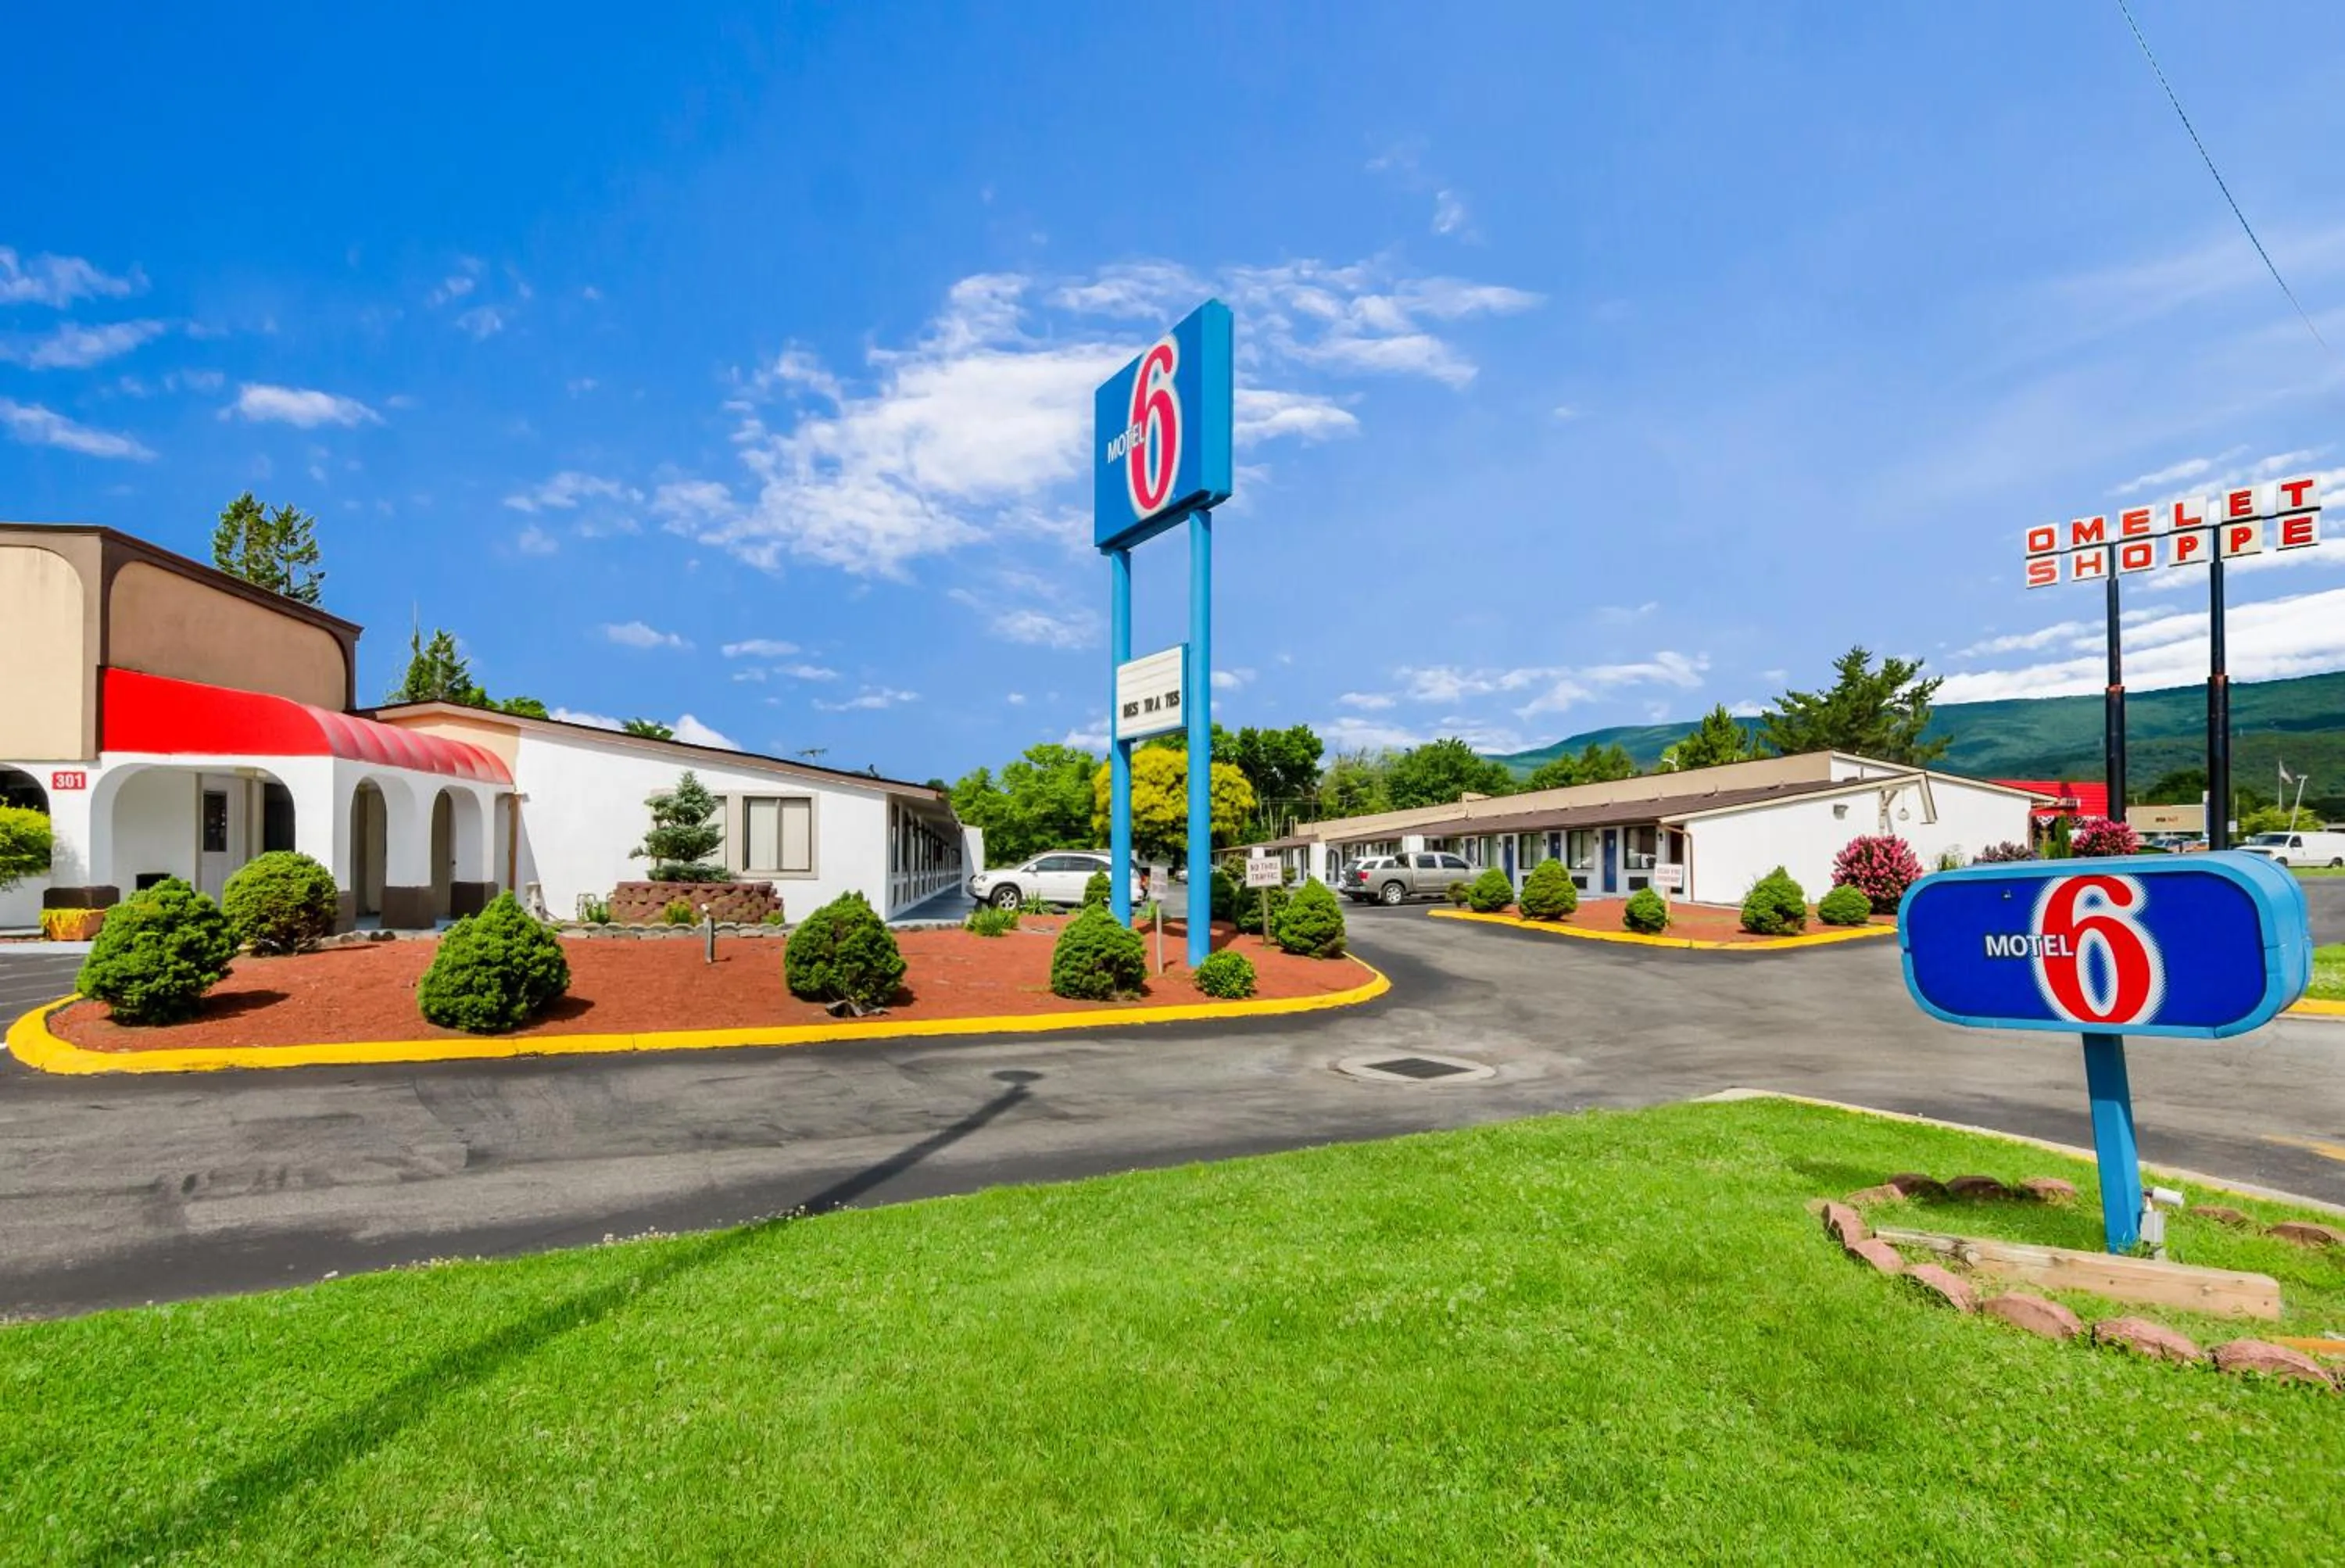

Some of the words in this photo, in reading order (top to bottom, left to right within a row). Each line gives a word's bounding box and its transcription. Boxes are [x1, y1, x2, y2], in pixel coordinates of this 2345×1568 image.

[1107, 421, 1145, 464] MOTEL
[1130, 342, 1177, 511] 6
[2028, 479, 2314, 553] OMELET
[2028, 516, 2313, 585] SHOPPE
[55, 773, 83, 789] 301
[1985, 934, 2075, 958] MOTEL
[2040, 874, 2151, 1023] 6
